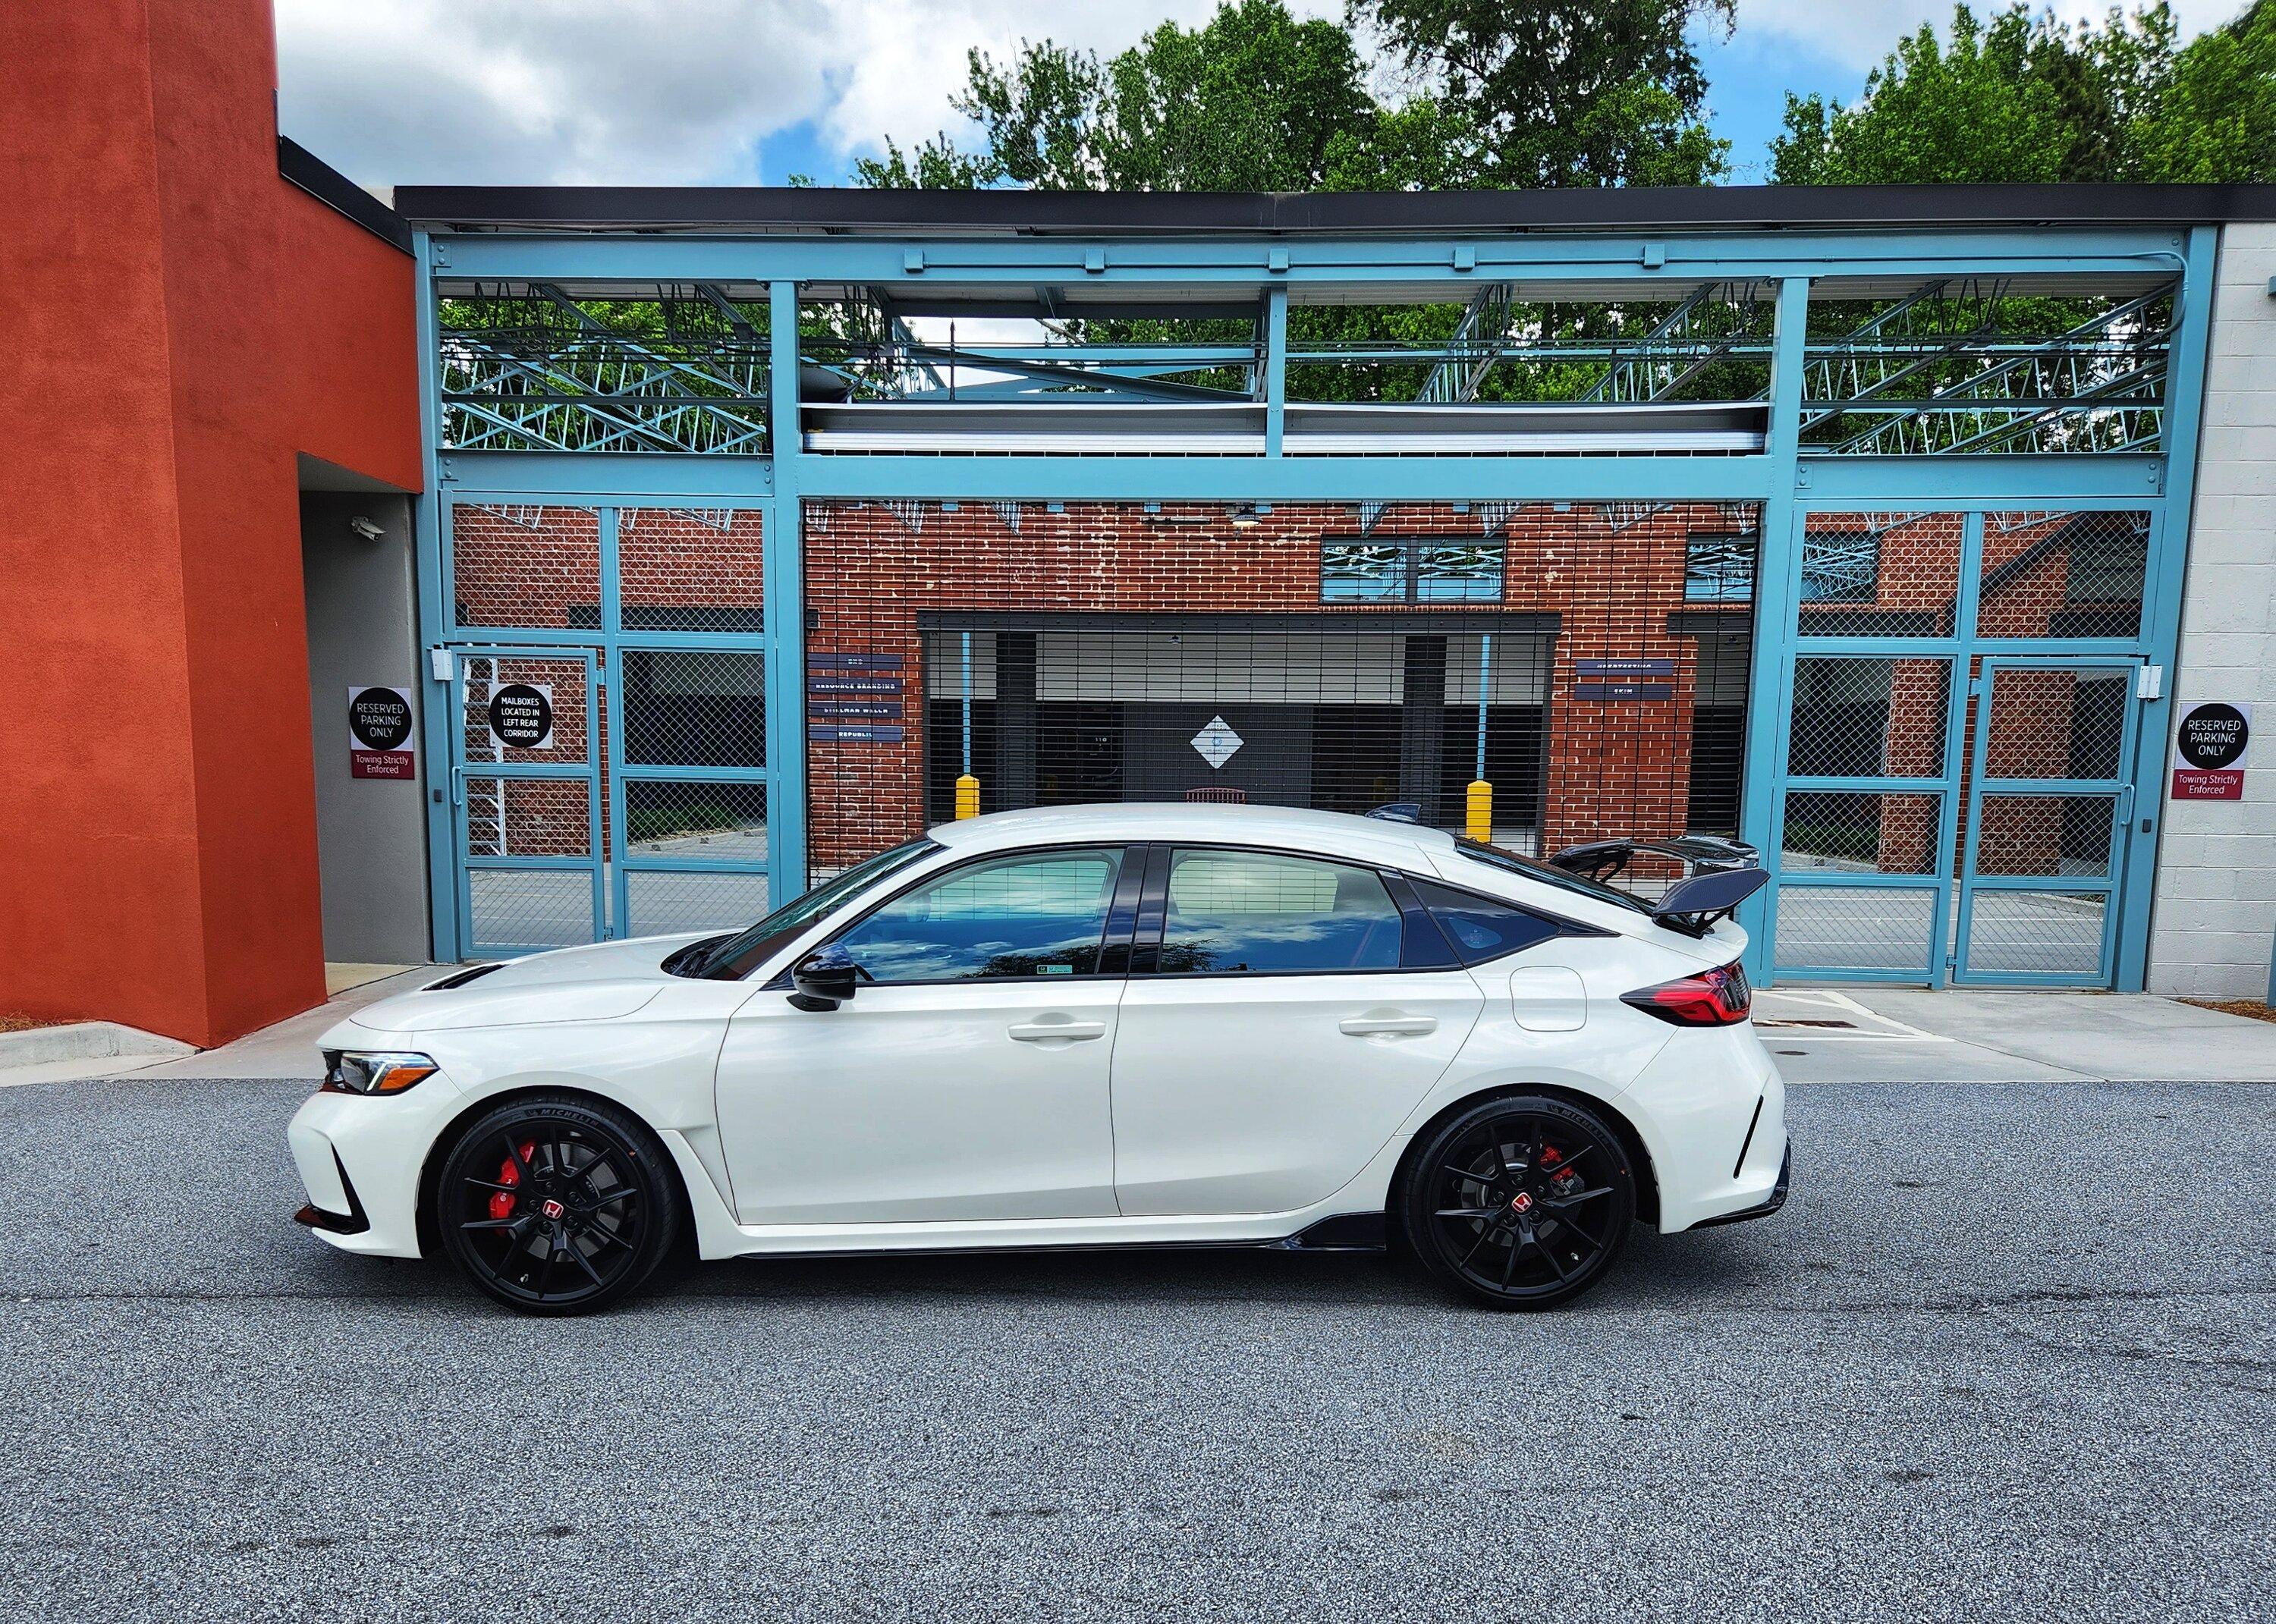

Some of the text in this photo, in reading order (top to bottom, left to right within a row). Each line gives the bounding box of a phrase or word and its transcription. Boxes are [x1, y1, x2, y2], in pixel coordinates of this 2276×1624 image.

[501, 697, 539, 706] MAILBOXES
[357, 703, 404, 714] RESERVED
[501, 708, 531, 716] LOCATED
[360, 715, 401, 726] PARKING
[503, 718, 539, 727] LEFT REAR
[2187, 720, 2241, 730] RESERVED
[369, 727, 394, 737] ONLY
[504, 729, 539, 738] CORRIDOR
[2190, 732, 2236, 743] PARKING
[2198, 745, 2226, 756] ONLY
[356, 754, 409, 766] Towing Strictly
[366, 765, 399, 774] Enforced
[2178, 774, 2238, 786] Towing Strictly
[2189, 784, 2225, 794] Enforced
[541, 1108, 599, 1128] MICHELIN
